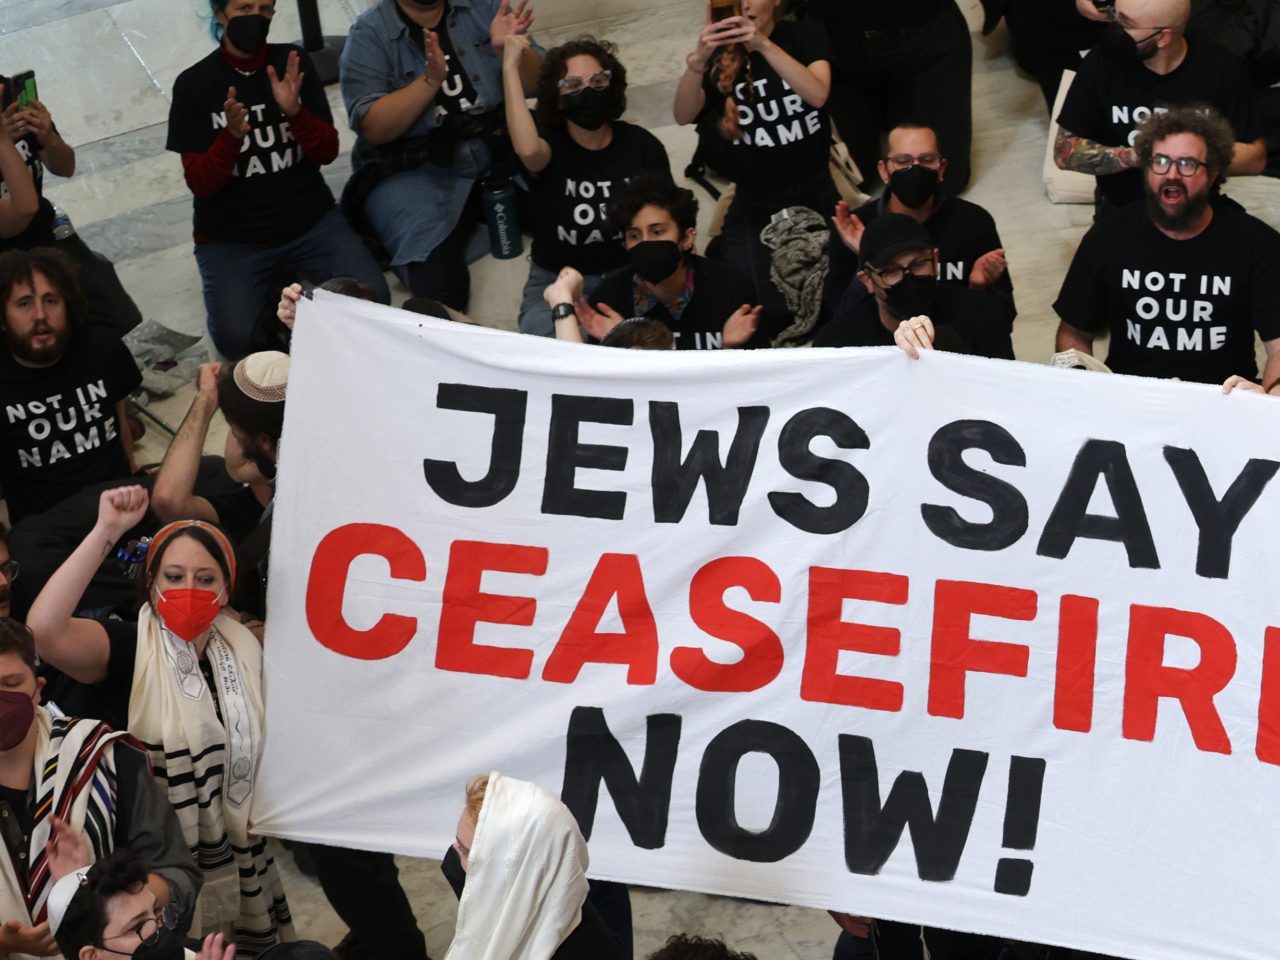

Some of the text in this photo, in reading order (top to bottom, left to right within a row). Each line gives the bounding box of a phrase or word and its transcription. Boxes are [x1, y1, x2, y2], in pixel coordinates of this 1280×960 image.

[211, 103, 266, 130] NT
[736, 94, 804, 126] OUR
[565, 178, 611, 199] NOT
[496, 213, 511, 254] Columbia
[1122, 269, 1231, 296] NOT IN
[1136, 297, 1214, 322] OUR
[1126, 319, 1227, 350] NAME
[5, 379, 108, 424] NOT IN
[28, 403, 103, 440] OUR
[18, 417, 118, 469] NAME
[424, 383, 1280, 579] JEWS SAY
[561, 706, 1046, 896] NOW!
